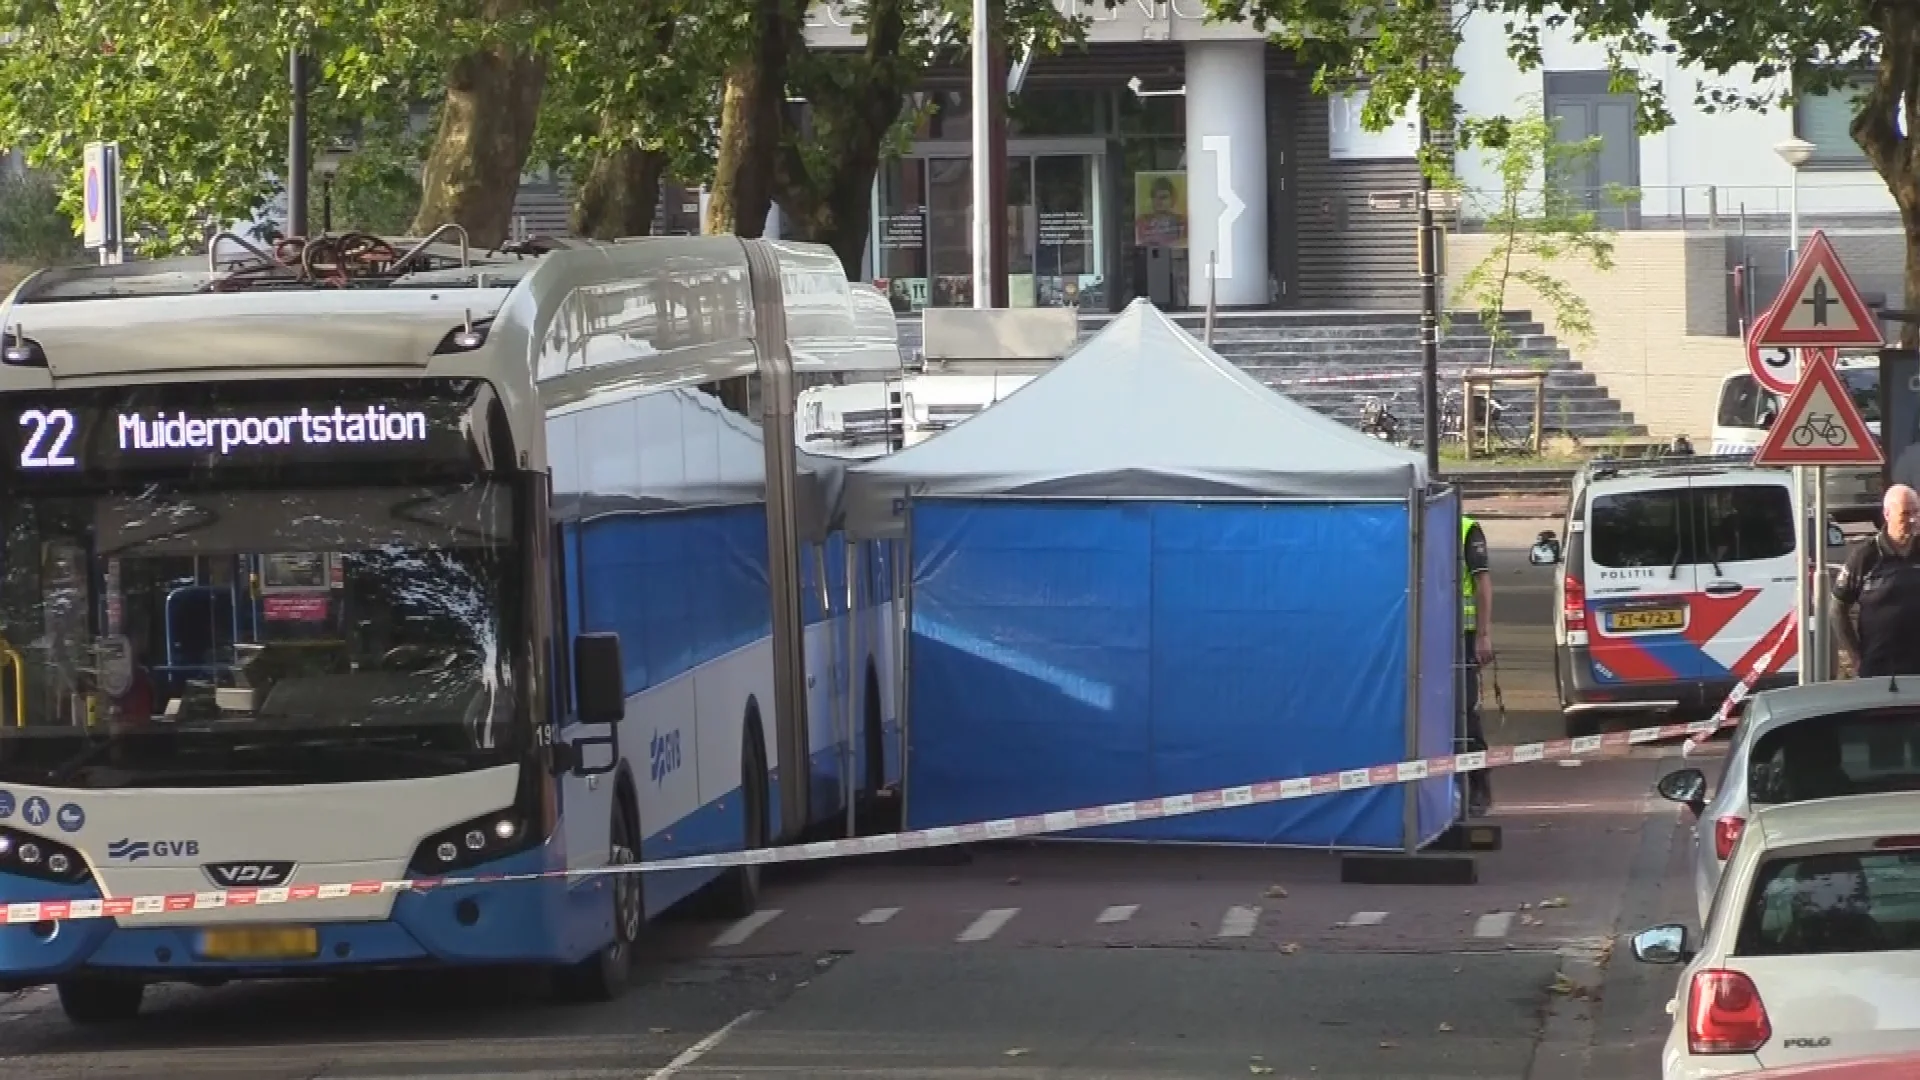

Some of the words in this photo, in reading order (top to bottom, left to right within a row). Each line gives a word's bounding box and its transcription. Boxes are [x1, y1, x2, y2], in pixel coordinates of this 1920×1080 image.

[18, 409, 76, 467] 22
[118, 405, 427, 454] Muiderpoortstation
[1600, 569, 1655, 579] POLITIE
[665, 728, 682, 773] GVB
[153, 840, 200, 857] GVB
[217, 865, 280, 882] VDL
[1783, 1036, 1832, 1049] POLO
